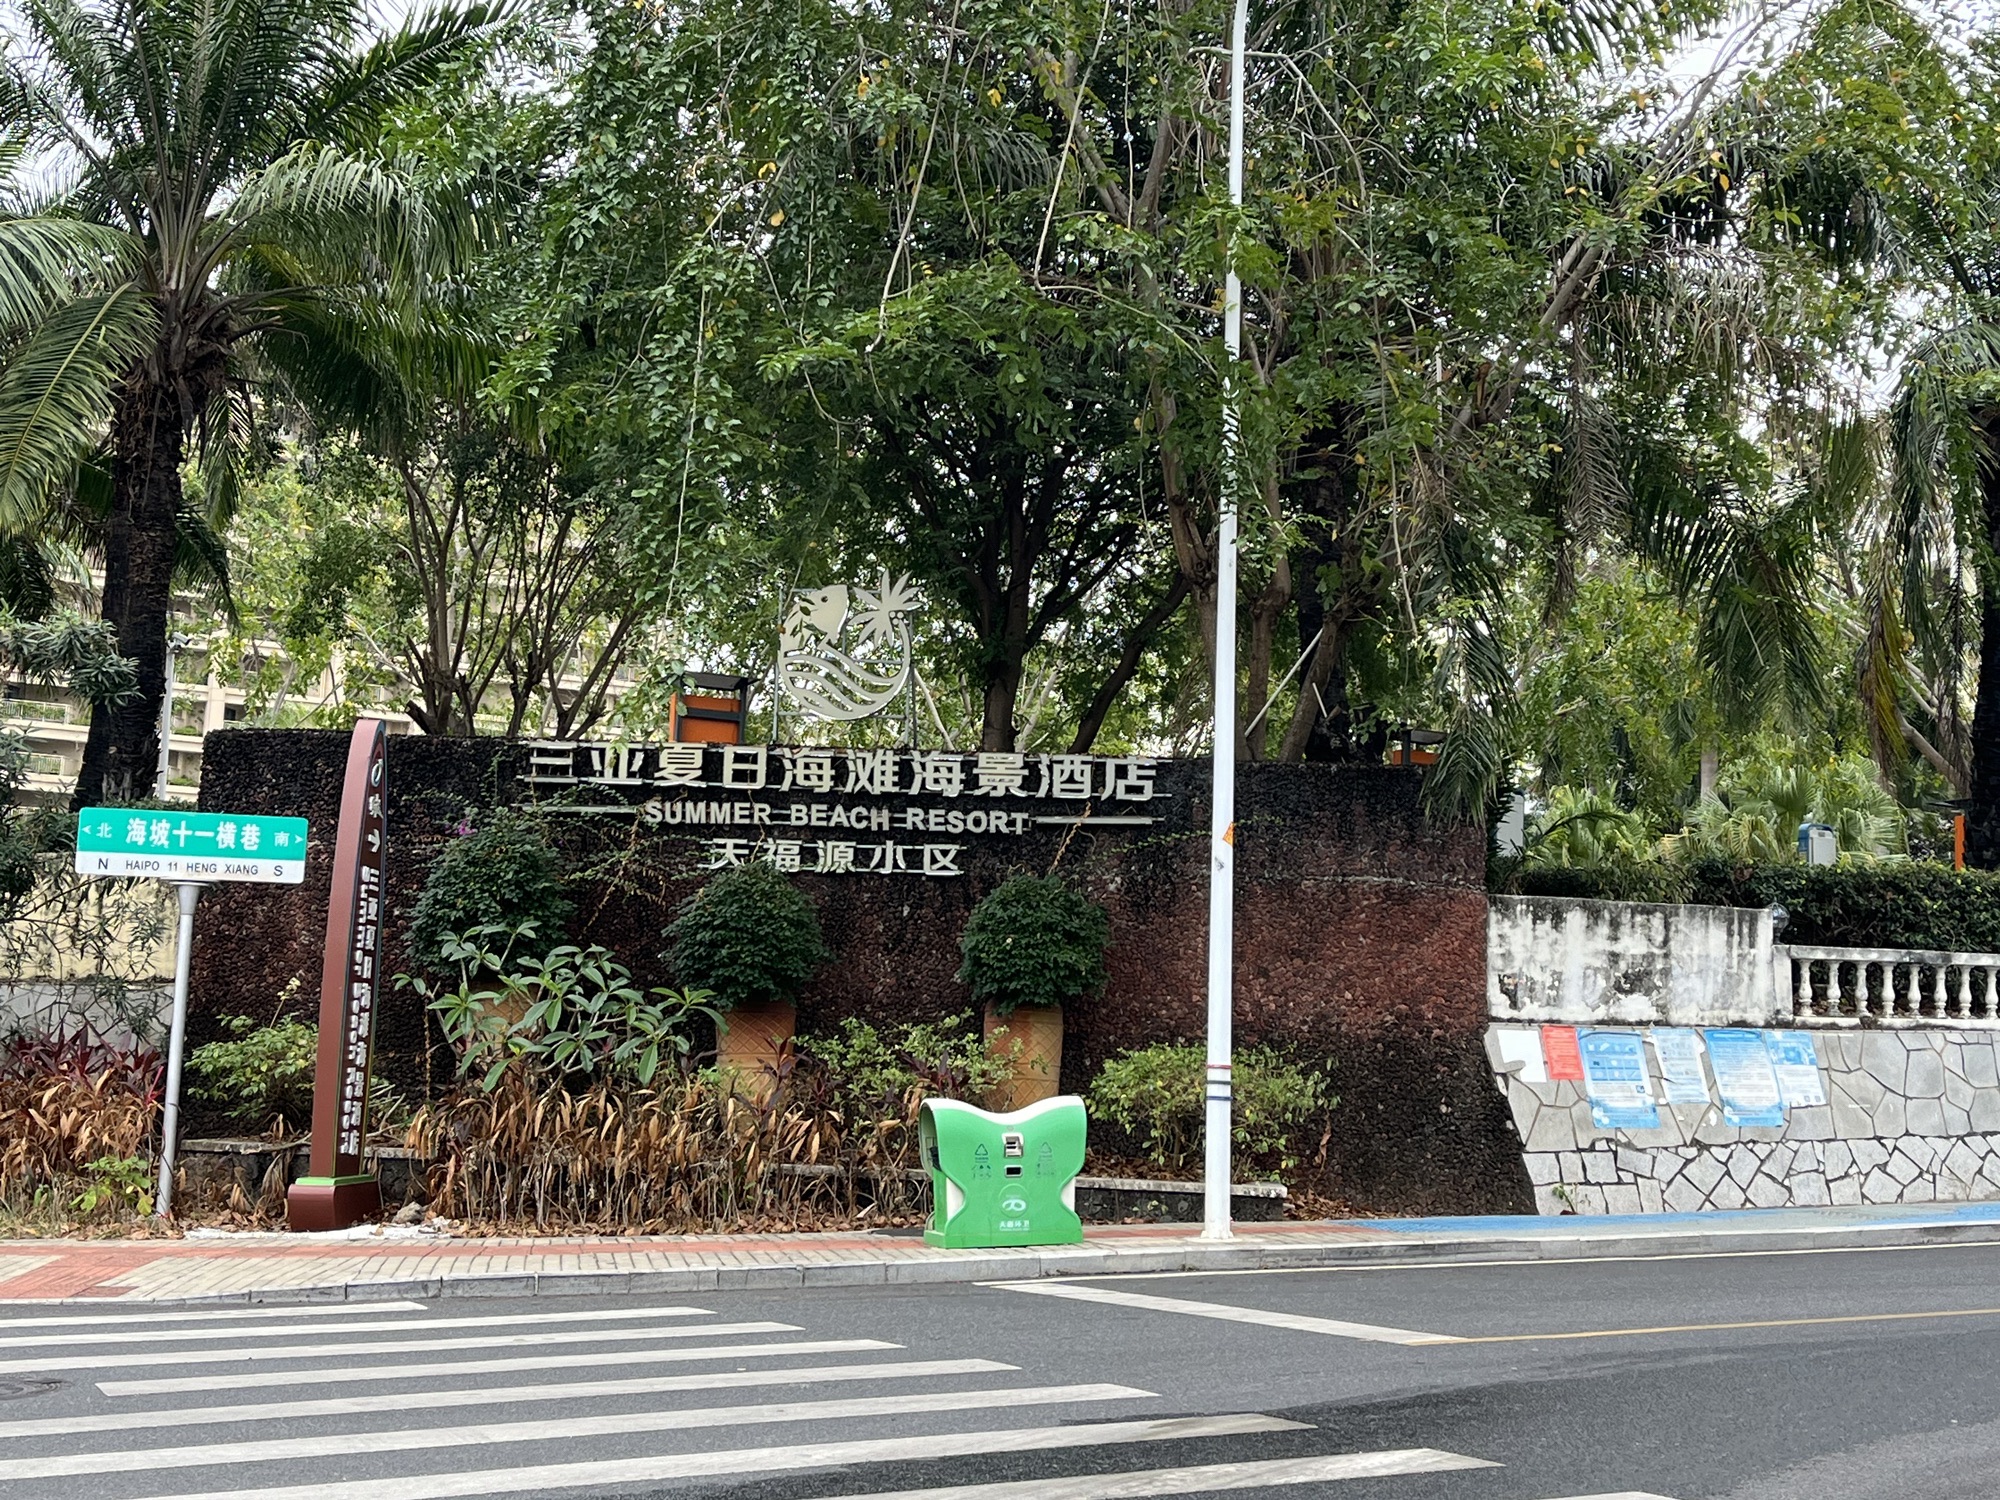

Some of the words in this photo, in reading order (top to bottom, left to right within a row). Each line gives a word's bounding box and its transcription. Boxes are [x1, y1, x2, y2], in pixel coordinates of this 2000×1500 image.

[525, 741, 1157, 801] 三亚夏日海滩海景酒店
[96, 822, 113, 839] 北
[125, 818, 261, 851] 海坡十一横巷
[274, 831, 290, 847] 南
[645, 801, 771, 825] SUMMER
[791, 804, 889, 831] BEACH
[906, 807, 1029, 835] RESORT
[98, 858, 109, 870] N
[125, 860, 160, 872] HAIPO
[168, 861, 178, 872] 11
[186, 863, 218, 874] HENG
[273, 865, 284, 876] S
[709, 838, 963, 876] 天福源小区
